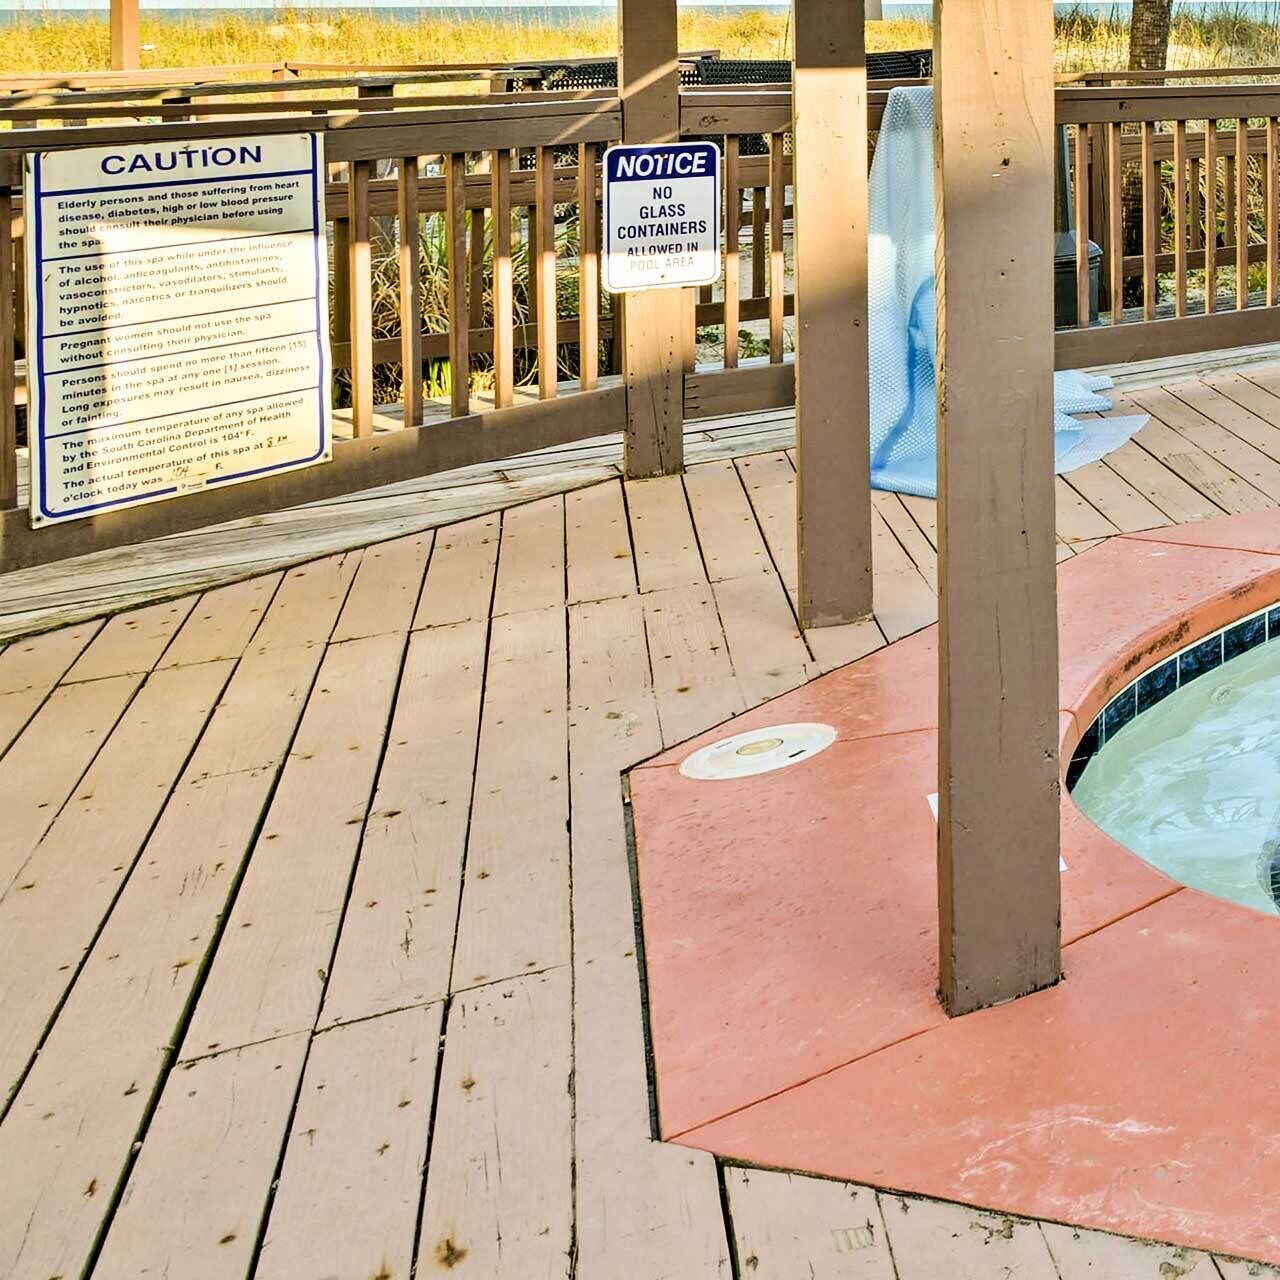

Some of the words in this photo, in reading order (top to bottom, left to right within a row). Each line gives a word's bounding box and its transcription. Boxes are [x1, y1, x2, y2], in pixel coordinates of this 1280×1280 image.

[101, 146, 262, 175] CAUTION
[616, 152, 708, 178] NOTICE
[57, 200, 96, 209] Elderly
[99, 197, 144, 206] persons
[147, 192, 168, 201] and
[170, 190, 198, 199] those
[201, 187, 246, 196] suffering
[274, 180, 299, 189] heart
[653, 186, 673, 200] NO
[57, 213, 104, 222] disease,
[107, 208, 159, 217] diabetes,
[162, 204, 184, 213] high
[186, 202, 197, 210] or
[199, 200, 217, 208] low
[220, 197, 249, 206] blood
[251, 195, 294, 205] pressure
[639, 204, 686, 219] GLASS
[58, 226, 95, 235] should
[143, 217, 168, 226] their
[170, 214, 219, 226] physician
[221, 209, 254, 218] before
[257, 206, 283, 215] using
[618, 220, 707, 240] CONTAINERS
[58, 240, 77, 248] the
[81, 239, 104, 247] spa.
[627, 243, 682, 257] ALLOWED
[687, 242, 699, 252] IN
[631, 260, 660, 272] POOL
[665, 257, 694, 268] AREA
